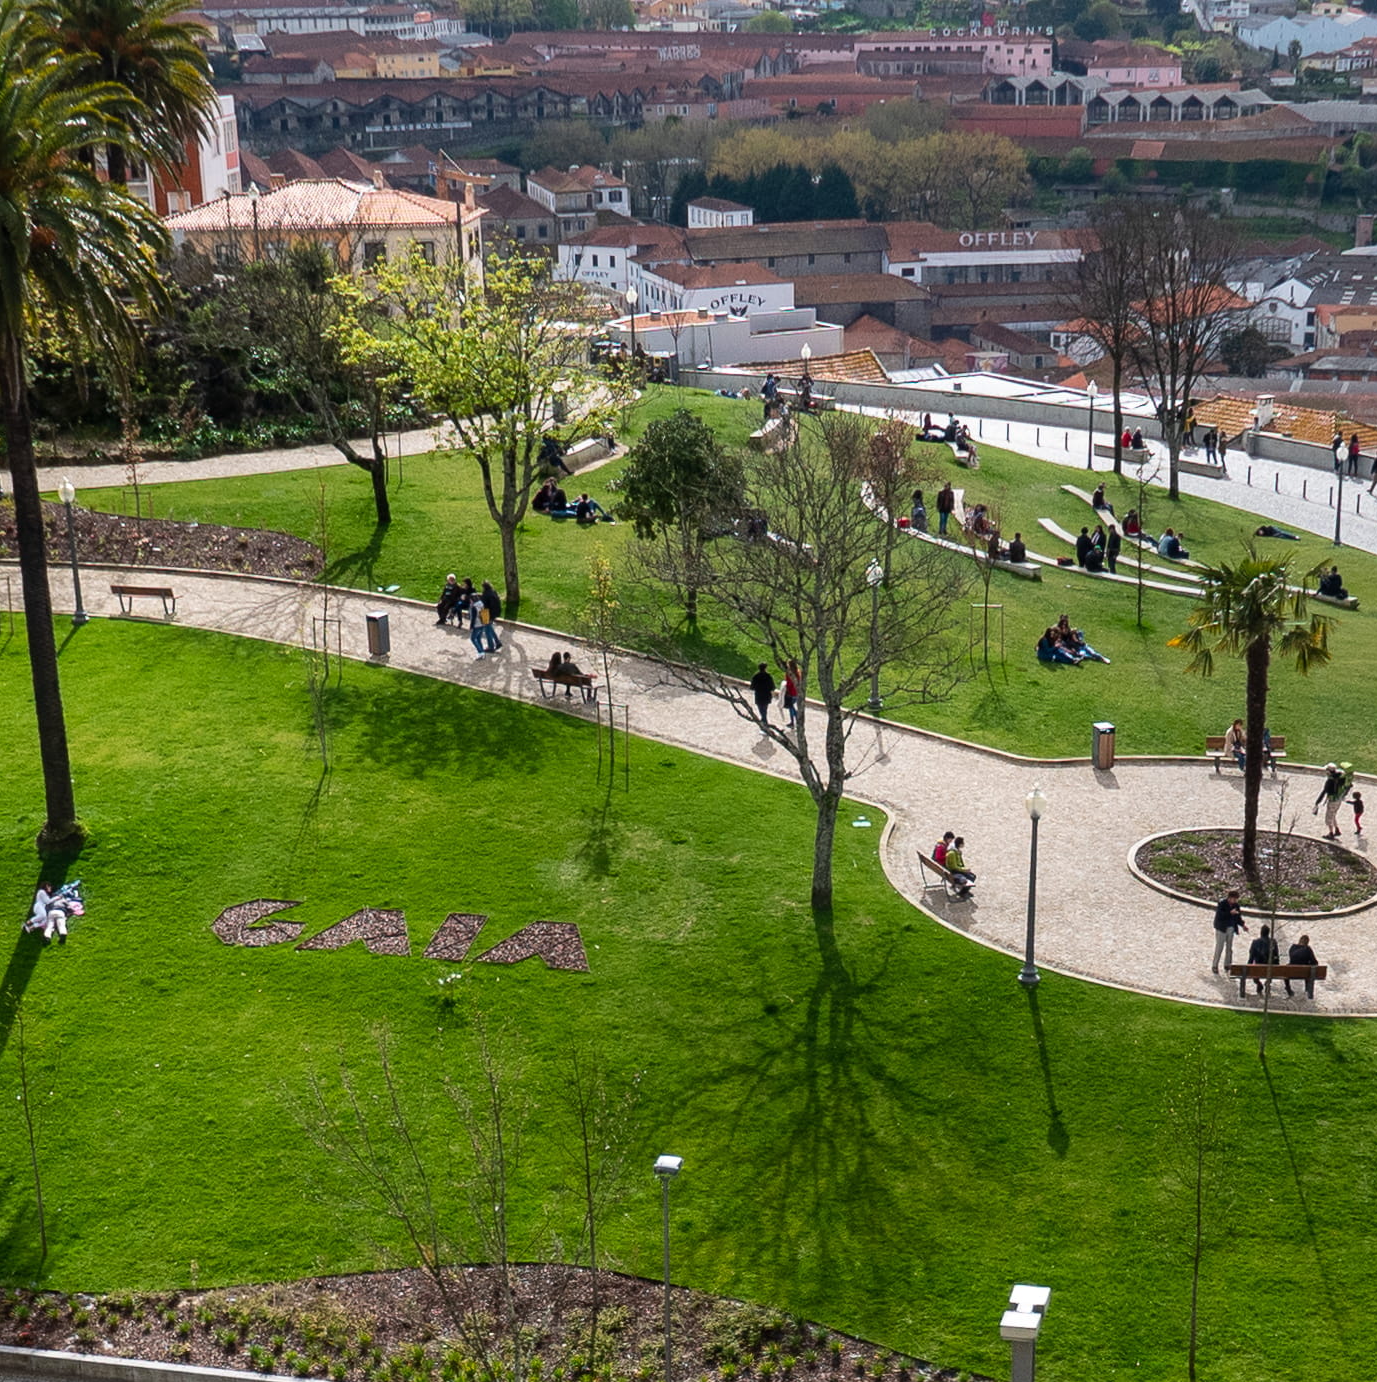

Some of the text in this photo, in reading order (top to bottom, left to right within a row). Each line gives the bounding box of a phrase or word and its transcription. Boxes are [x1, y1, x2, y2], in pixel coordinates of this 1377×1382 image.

[929, 25, 1054, 37] COCKBURN'S
[958, 231, 1039, 247] OFFLEY
[582, 270, 609, 279] OFFLEY
[710, 293, 766, 310] OFFLEY
[210, 898, 591, 973] GAIA
